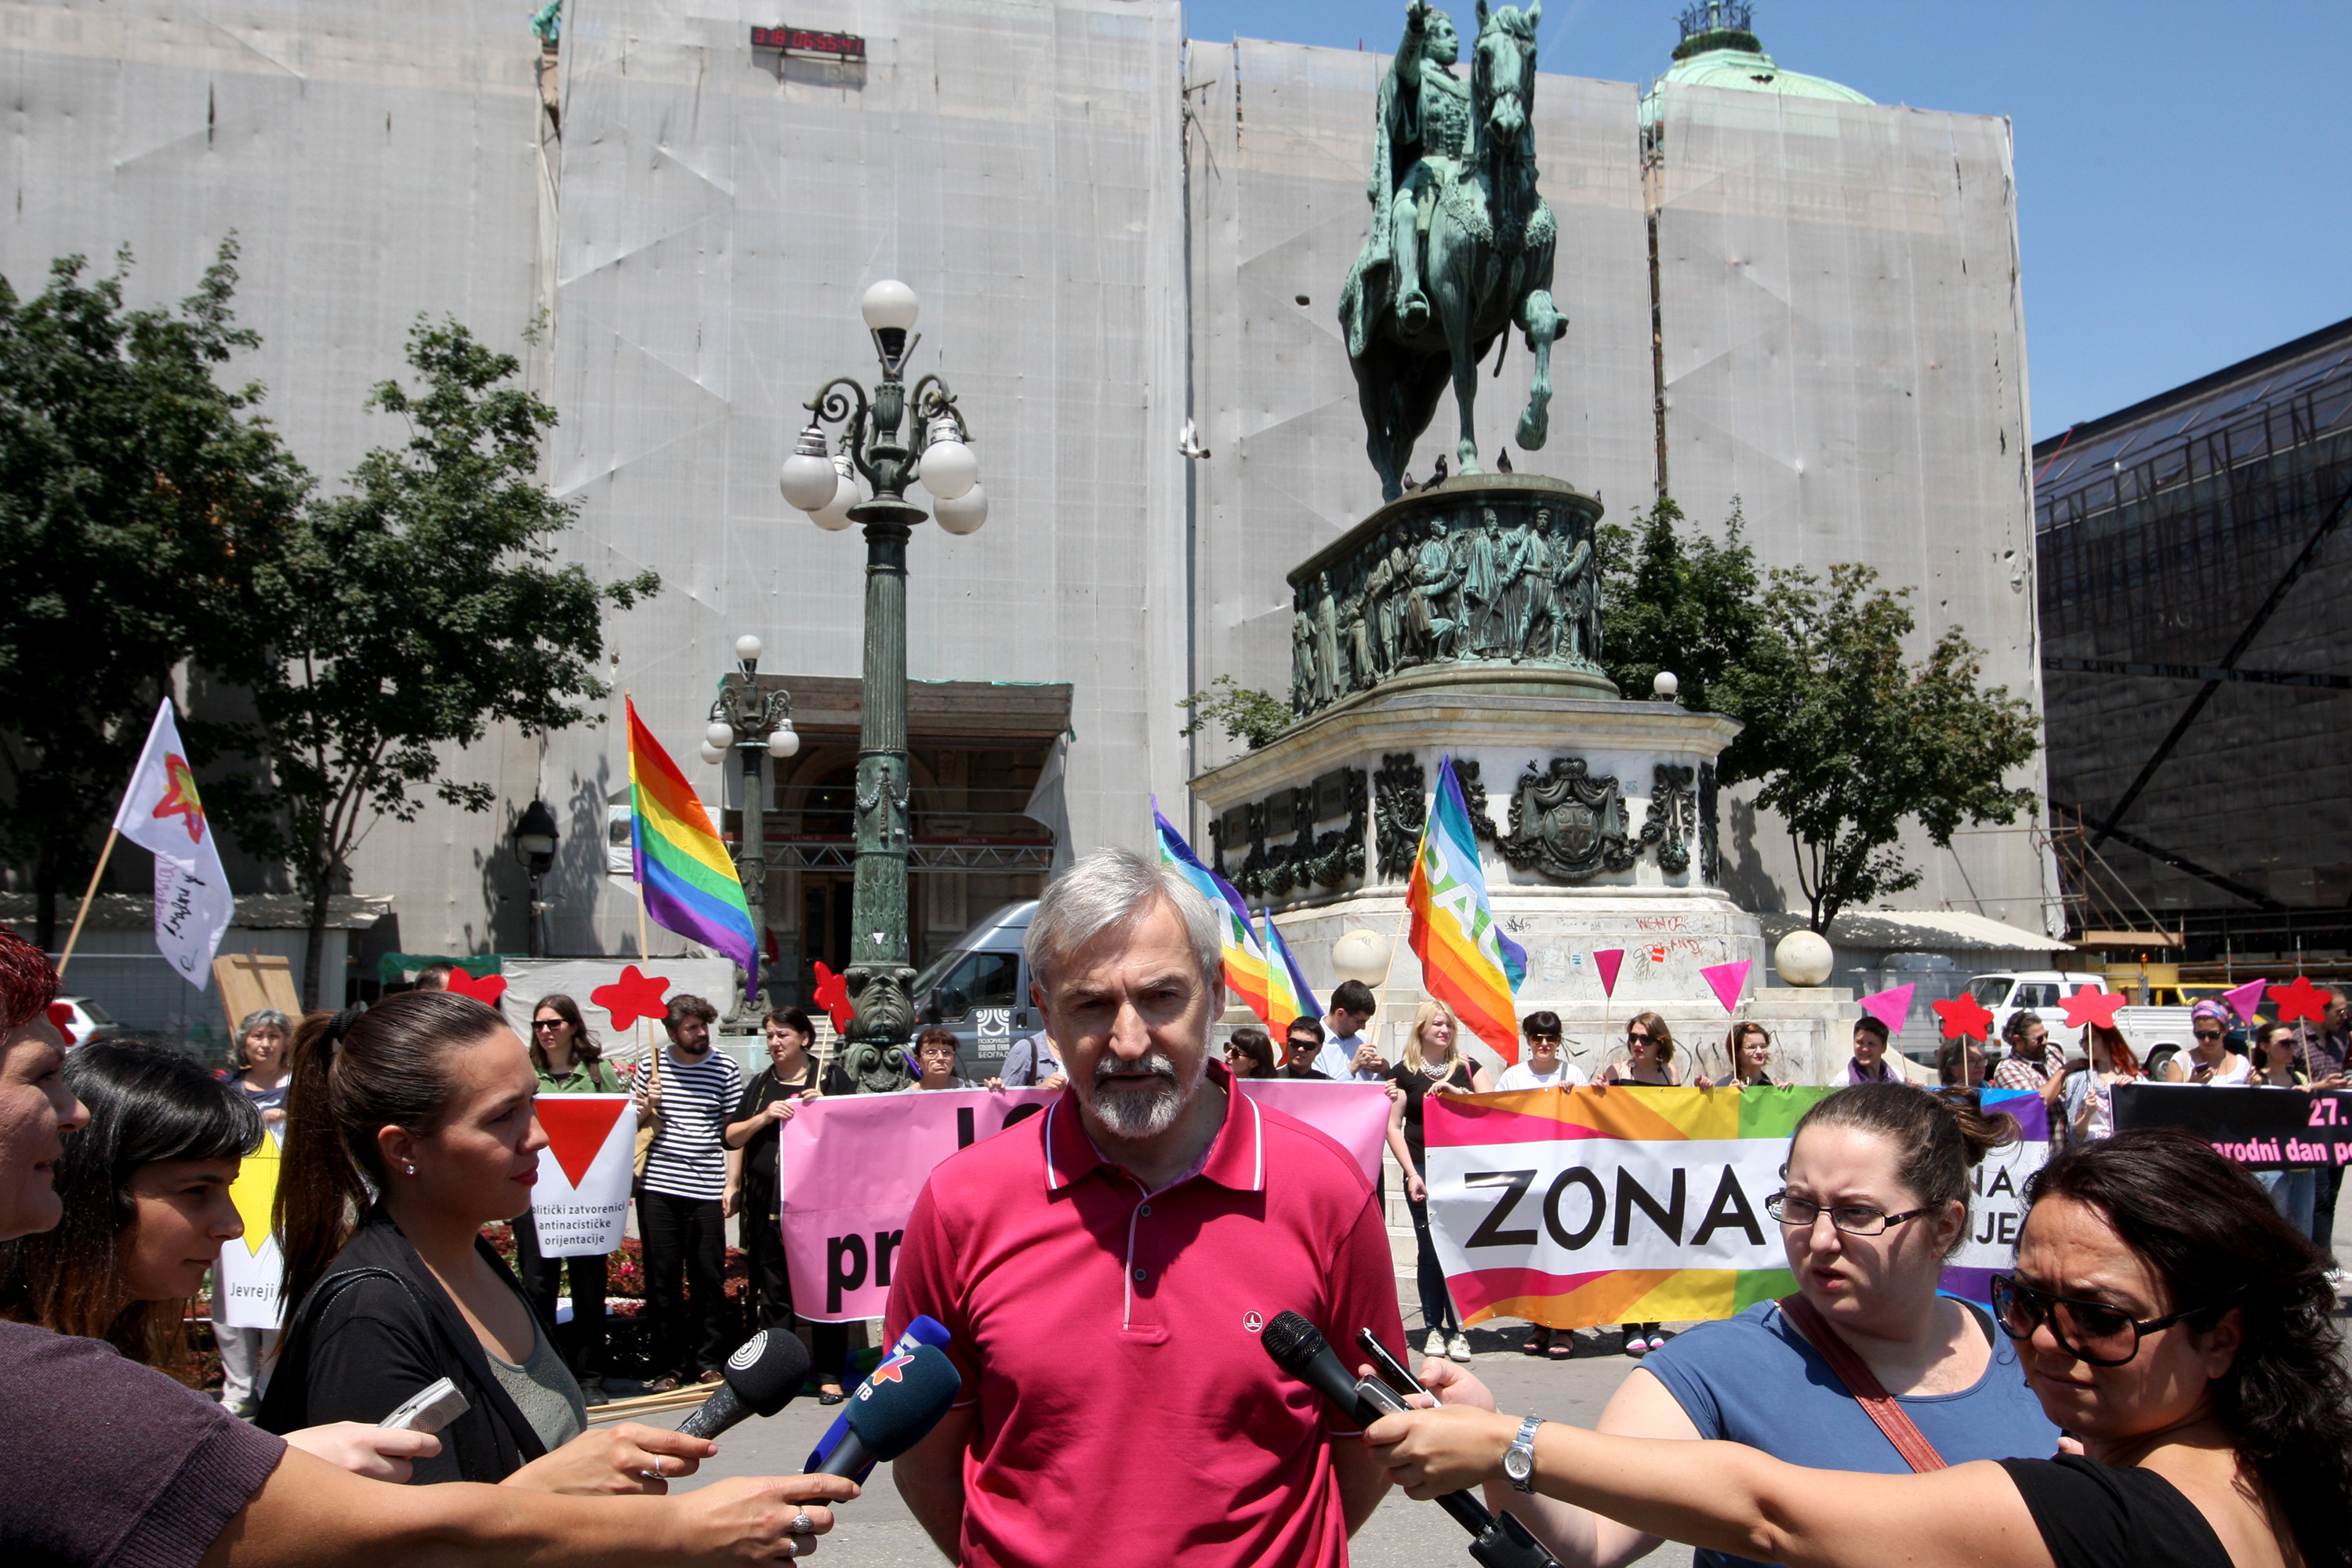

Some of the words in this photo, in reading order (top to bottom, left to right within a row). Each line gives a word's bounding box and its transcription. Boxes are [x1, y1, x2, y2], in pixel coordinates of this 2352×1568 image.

[754, 27, 786, 45] 318
[792, 31, 862, 53] 06:55:41
[2308, 1098, 2349, 1127] 27.
[2210, 1137, 2282, 1163] arodni
[2285, 1137, 2328, 1162] dan
[532, 1203, 566, 1215] olitički
[568, 1200, 626, 1214] zatvorenici
[1464, 1163, 1766, 1250] ZONA
[539, 1218, 612, 1230] antinacističke
[544, 1233, 605, 1247] orijentacije
[826, 1228, 904, 1314] pr
[230, 1282, 274, 1301] Jevreji
